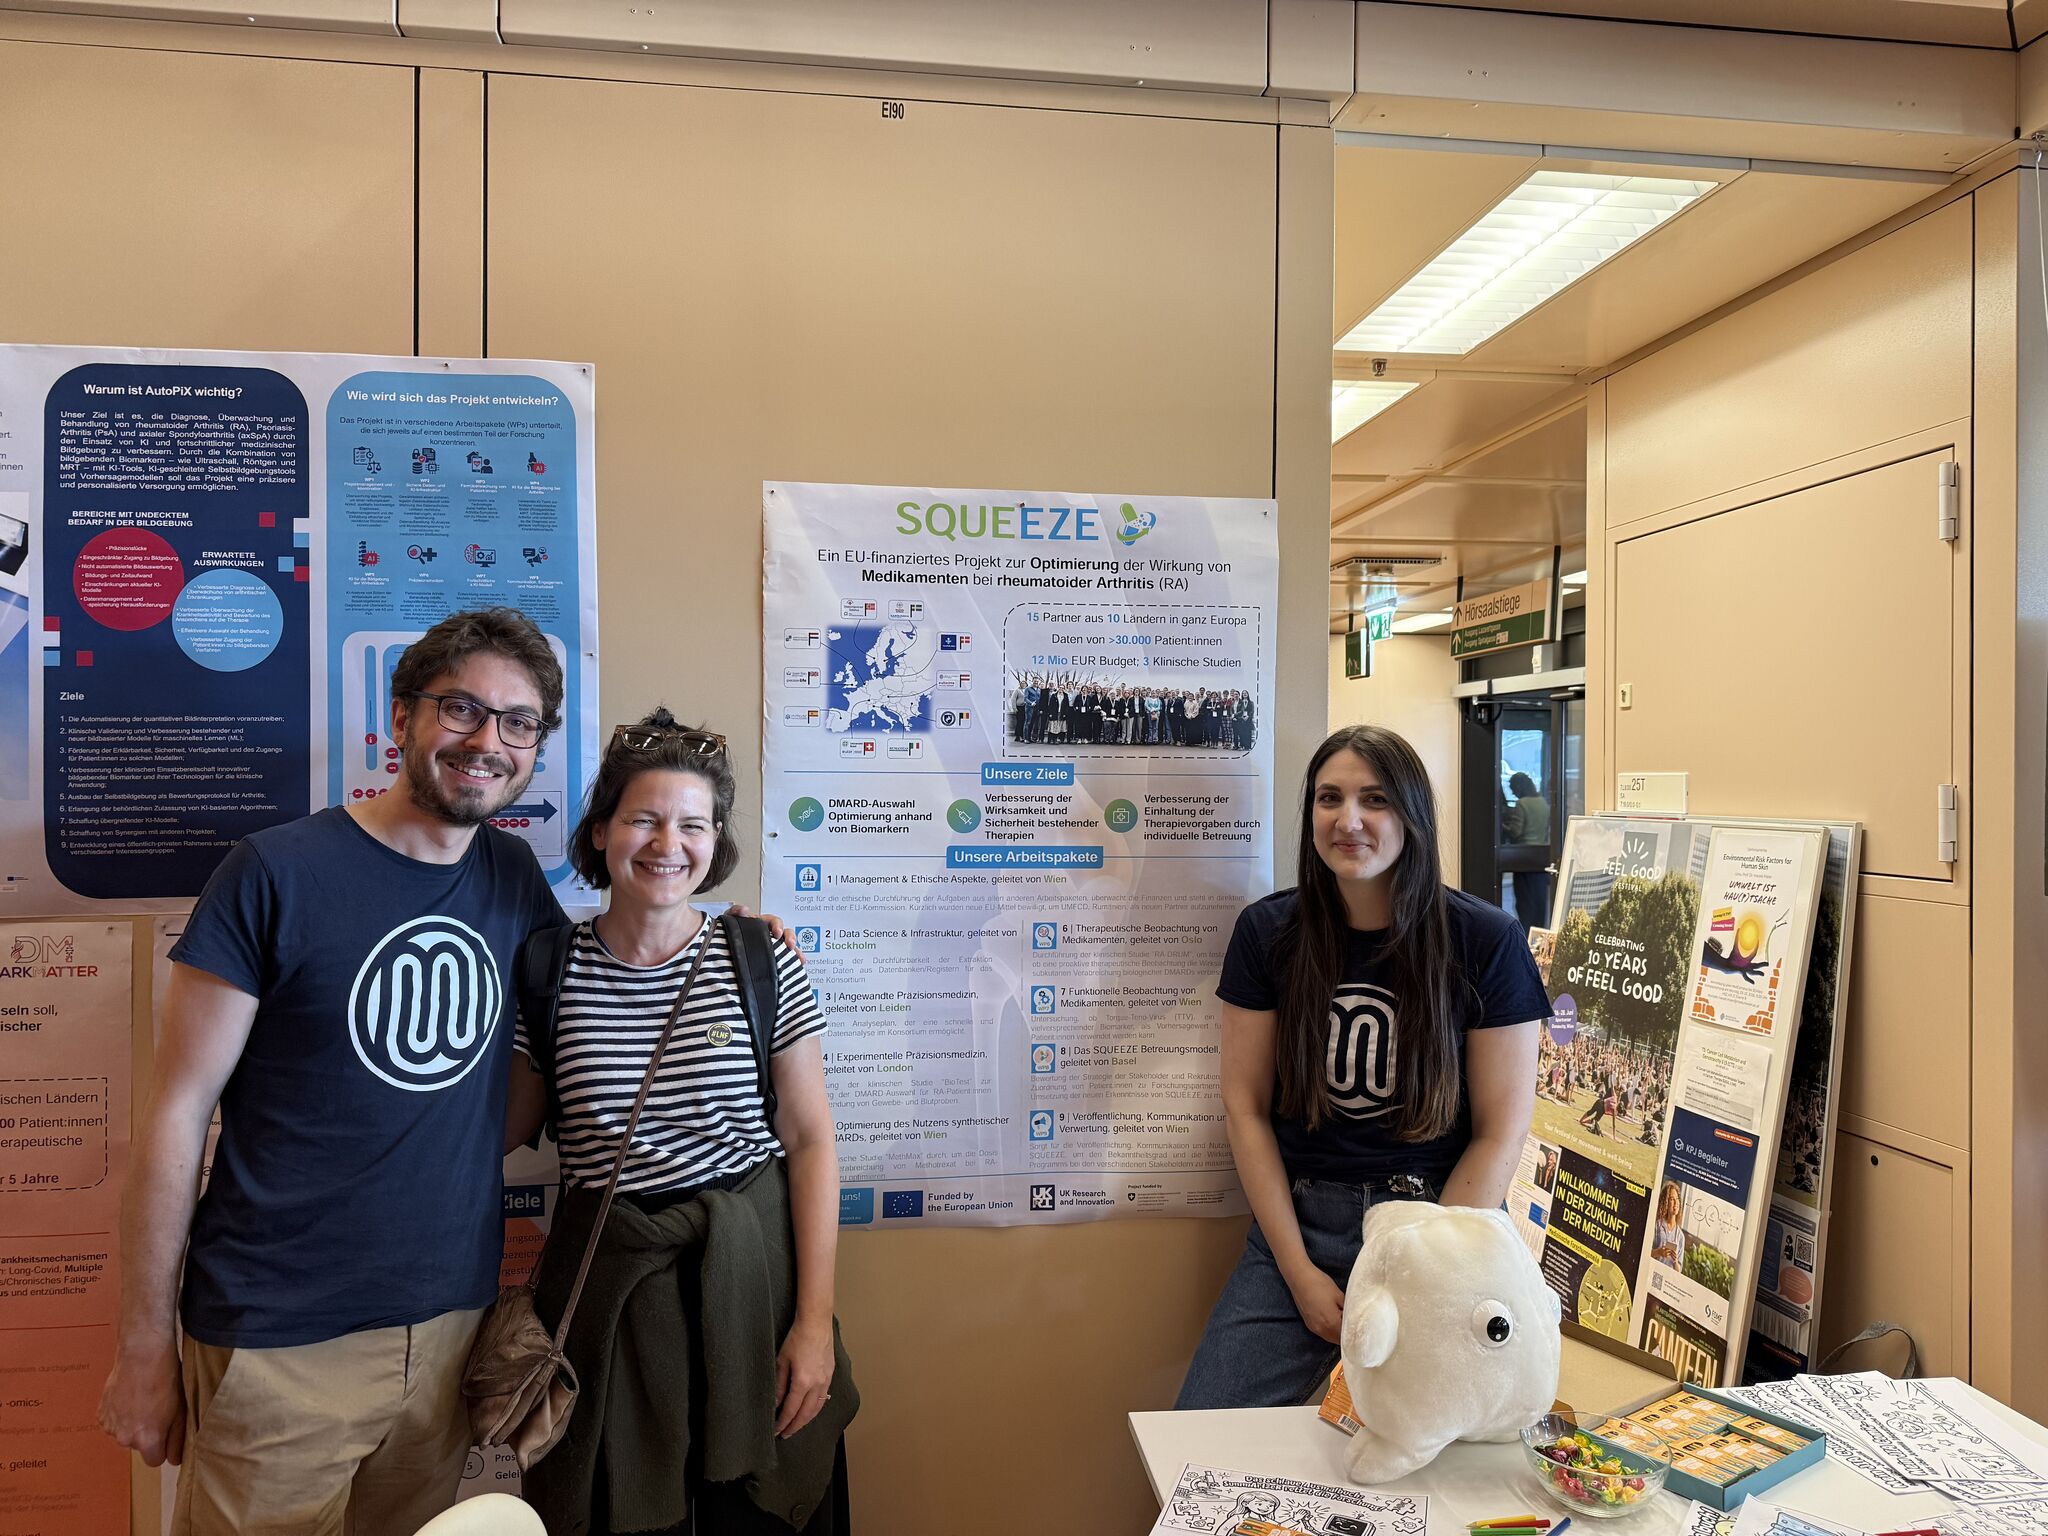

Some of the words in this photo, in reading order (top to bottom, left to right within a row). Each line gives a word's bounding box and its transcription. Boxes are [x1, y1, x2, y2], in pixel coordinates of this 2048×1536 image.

[882, 102, 904, 119] EI90
[83, 384, 125, 394] Warum
[128, 385, 142, 395] ist
[144, 385, 192, 396] AutoPiX
[194, 386, 242, 399] wichtig?
[346, 390, 368, 400] Wie
[370, 391, 396, 401] wird
[399, 392, 423, 402] sich
[426, 393, 446, 403] das
[450, 394, 489, 406] Projekt
[492, 395, 558, 405] entwickeln?
[60, 410, 85, 418] Unser
[170, 413, 210, 422] Diagnose,
[217, 413, 273, 424] Überwachung
[896, 502, 1100, 541] SQUEEZE
[818, 548, 839, 561] Ein
[845, 550, 950, 565] EU-finanziertes
[954, 553, 1001, 570] Projekt
[1005, 558, 1026, 568] zur
[1030, 557, 1119, 574] Optimierung
[1123, 558, 1144, 571] der
[1148, 559, 1203, 575] Wirkung
[1207, 563, 1230, 572] von
[862, 569, 968, 584] Medikamenten
[973, 573, 992, 585] bei
[997, 575, 1092, 588] rheumatoider
[1096, 575, 1154, 589] Arthritis
[1159, 577, 1188, 591] (RA)
[1464, 595, 1520, 622] Hörsaalstiege
[1026, 612, 1039, 621] 15
[1042, 612, 1081, 622] Partner
[1084, 614, 1104, 623] aus
[1107, 613, 1120, 623] 10
[1123, 614, 1166, 623] Ländern
[1169, 614, 1178, 624] in
[1181, 616, 1207, 627] ganz
[1210, 614, 1246, 627] Europa
[1051, 633, 1083, 644] Daten
[1085, 636, 1105, 644] von
[1108, 634, 1151, 644] >30.000
[1154, 635, 1222, 645] Patient:innen
[1031, 655, 1044, 664] 12
[1047, 655, 1068, 665] Mio
[1071, 655, 1096, 665] EUR
[1099, 655, 1139, 668] Budget;
[1143, 656, 1150, 666] 3
[1152, 656, 1199, 666] Klinische
[1202, 656, 1241, 667] Studien
[59, 691, 84, 700] Ziele
[984, 767, 1032, 779] Unsere
[1036, 768, 1068, 779] Ziele
[828, 798, 915, 808] DMARD-Auswahl
[984, 793, 1053, 804] Verbesserung
[1056, 793, 1072, 802] der
[984, 806, 1046, 814] Wirksamkeit
[1048, 806, 1067, 814] und
[828, 811, 891, 822] Optimierung
[894, 812, 932, 820] anhand
[984, 818, 1034, 827] Sicherheit
[1037, 818, 1099, 827] bestehender
[850, 824, 909, 833] Biomarkern
[984, 830, 1034, 841] Therapien
[954, 850, 1002, 862] Unsere
[1005, 850, 1098, 864] Arbeitspakete
[1723, 854, 1755, 862] Environmental
[1602, 860, 1626, 877] FEEL
[1630, 864, 1662, 880] GOOD
[827, 874, 831, 883] 1
[840, 874, 899, 885] Management
[901, 874, 908, 883] &
[910, 874, 948, 883] Ethische
[950, 874, 988, 884] Aspekte,
[991, 875, 1023, 885] geleitet
[1043, 874, 1066, 883] Wien
[1614, 882, 1642, 892] FESTIVAL
[1729, 881, 1762, 890] UMWELT
[1763, 884, 1776, 892] IST
[1595, 934, 1645, 952] CELEBRATING
[1588, 949, 1600, 965] 10
[1604, 952, 1647, 976] YEARS
[1567, 966, 1584, 984] OF
[1585, 970, 1618, 994] FEEL
[1622, 978, 1662, 1004] GOOD
[33, 1005, 58, 1016] soll,
[46, 1093, 98, 1103] Ländern
[20, 1116, 102, 1128] Patient:innen
[1698, 1149, 1728, 1169] Begleiter
[9, 1175, 16, 1184] 5
[21, 1173, 59, 1184] Jahre
[928, 1192, 961, 1201] Funded
[963, 1191, 974, 1201] by
[1559, 1168, 1619, 1212] WILLKOMMEN
[928, 1203, 942, 1212] the
[944, 1202, 985, 1213] European
[988, 1200, 1013, 1209] Union
[1556, 1185, 1566, 1201] IN
[1566, 1191, 1585, 1211] DER
[1585, 1202, 1629, 1236] ZUKUNFT
[1563, 1208, 1581, 1229] DER
[1582, 1219, 1621, 1253] MEDIZIN
[9, 1265, 62, 1276] Long-Covid,
[64, 1264, 103, 1273] Multiple
[64, 1275, 101, 1285] Fatigue-
[30, 1286, 86, 1296] entzündliche
[9, 1459, 47, 1472] geleitet
